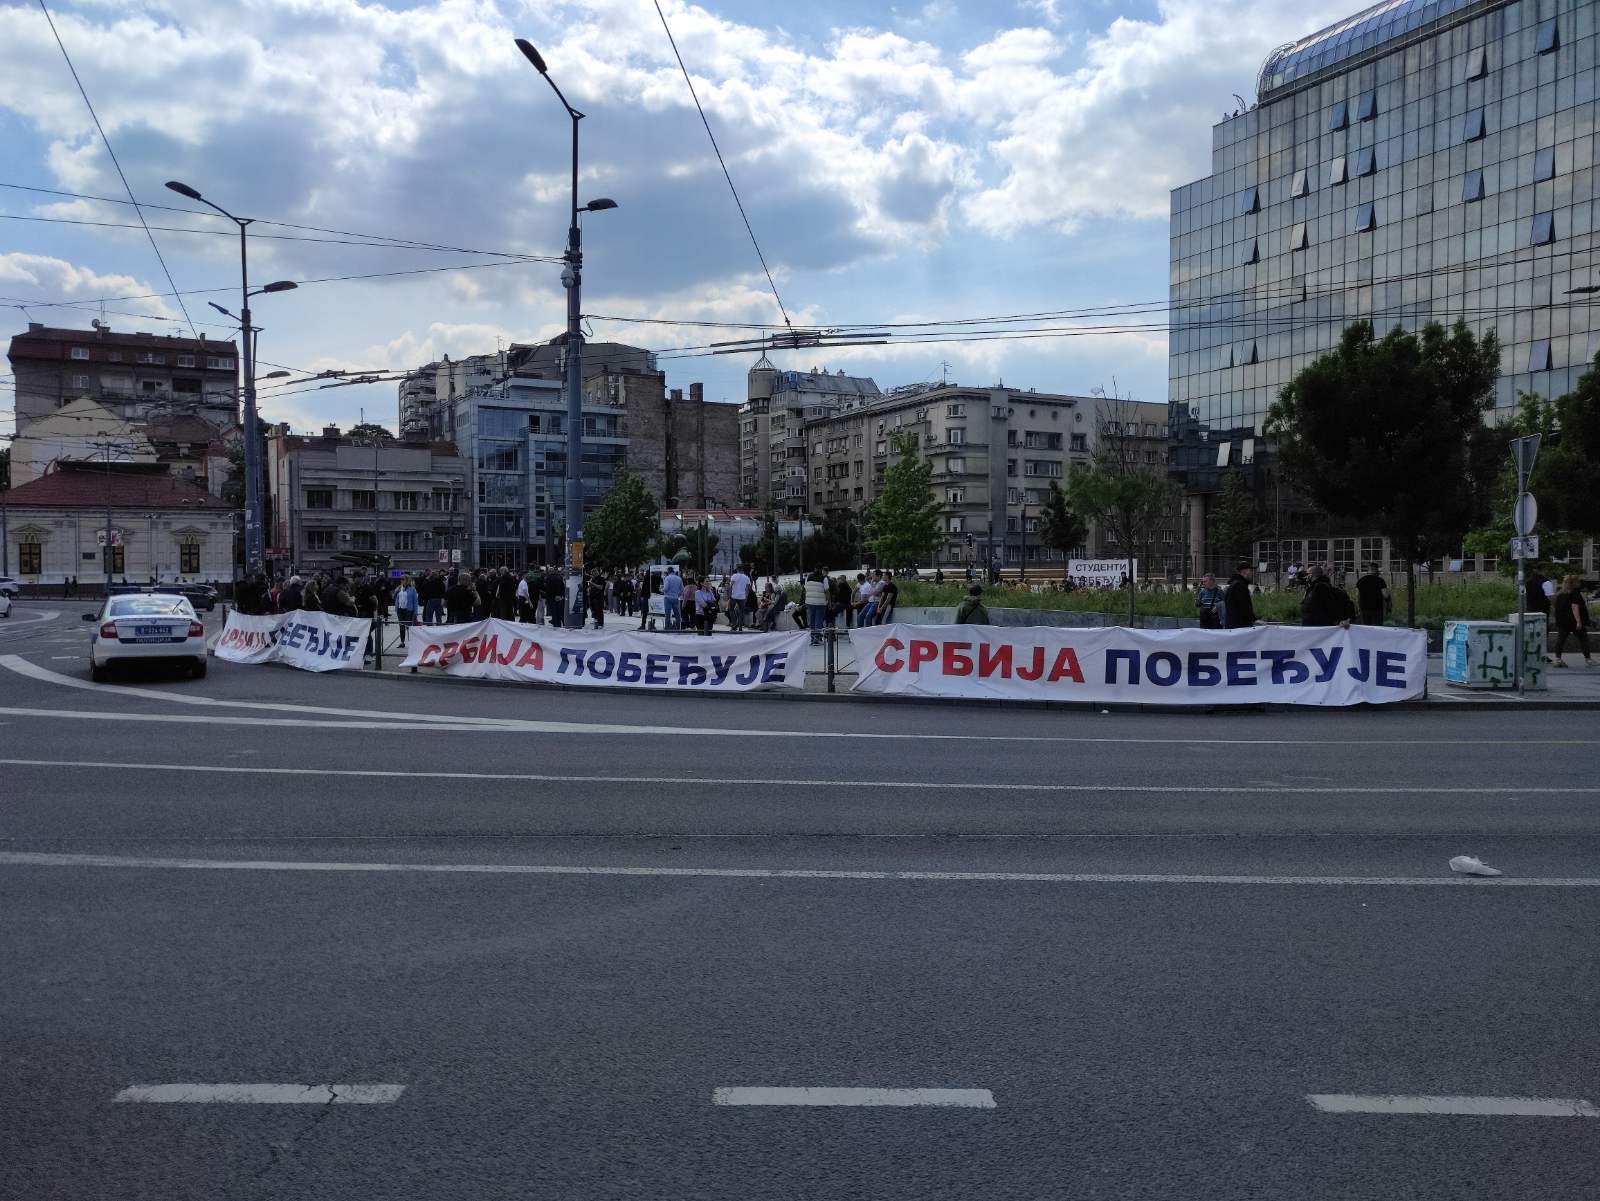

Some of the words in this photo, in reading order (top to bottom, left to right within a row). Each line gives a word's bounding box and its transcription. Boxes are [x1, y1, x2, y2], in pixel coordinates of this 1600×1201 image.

[1075, 563, 1127, 572] СТУДЕНТИ
[418, 634, 544, 671] СРБИЈА
[556, 646, 789, 686] ПОБЕЂУЈЕ
[874, 638, 1085, 683] СРБИЈА
[1104, 646, 1407, 689] ПОБЕЂУЈЕ
